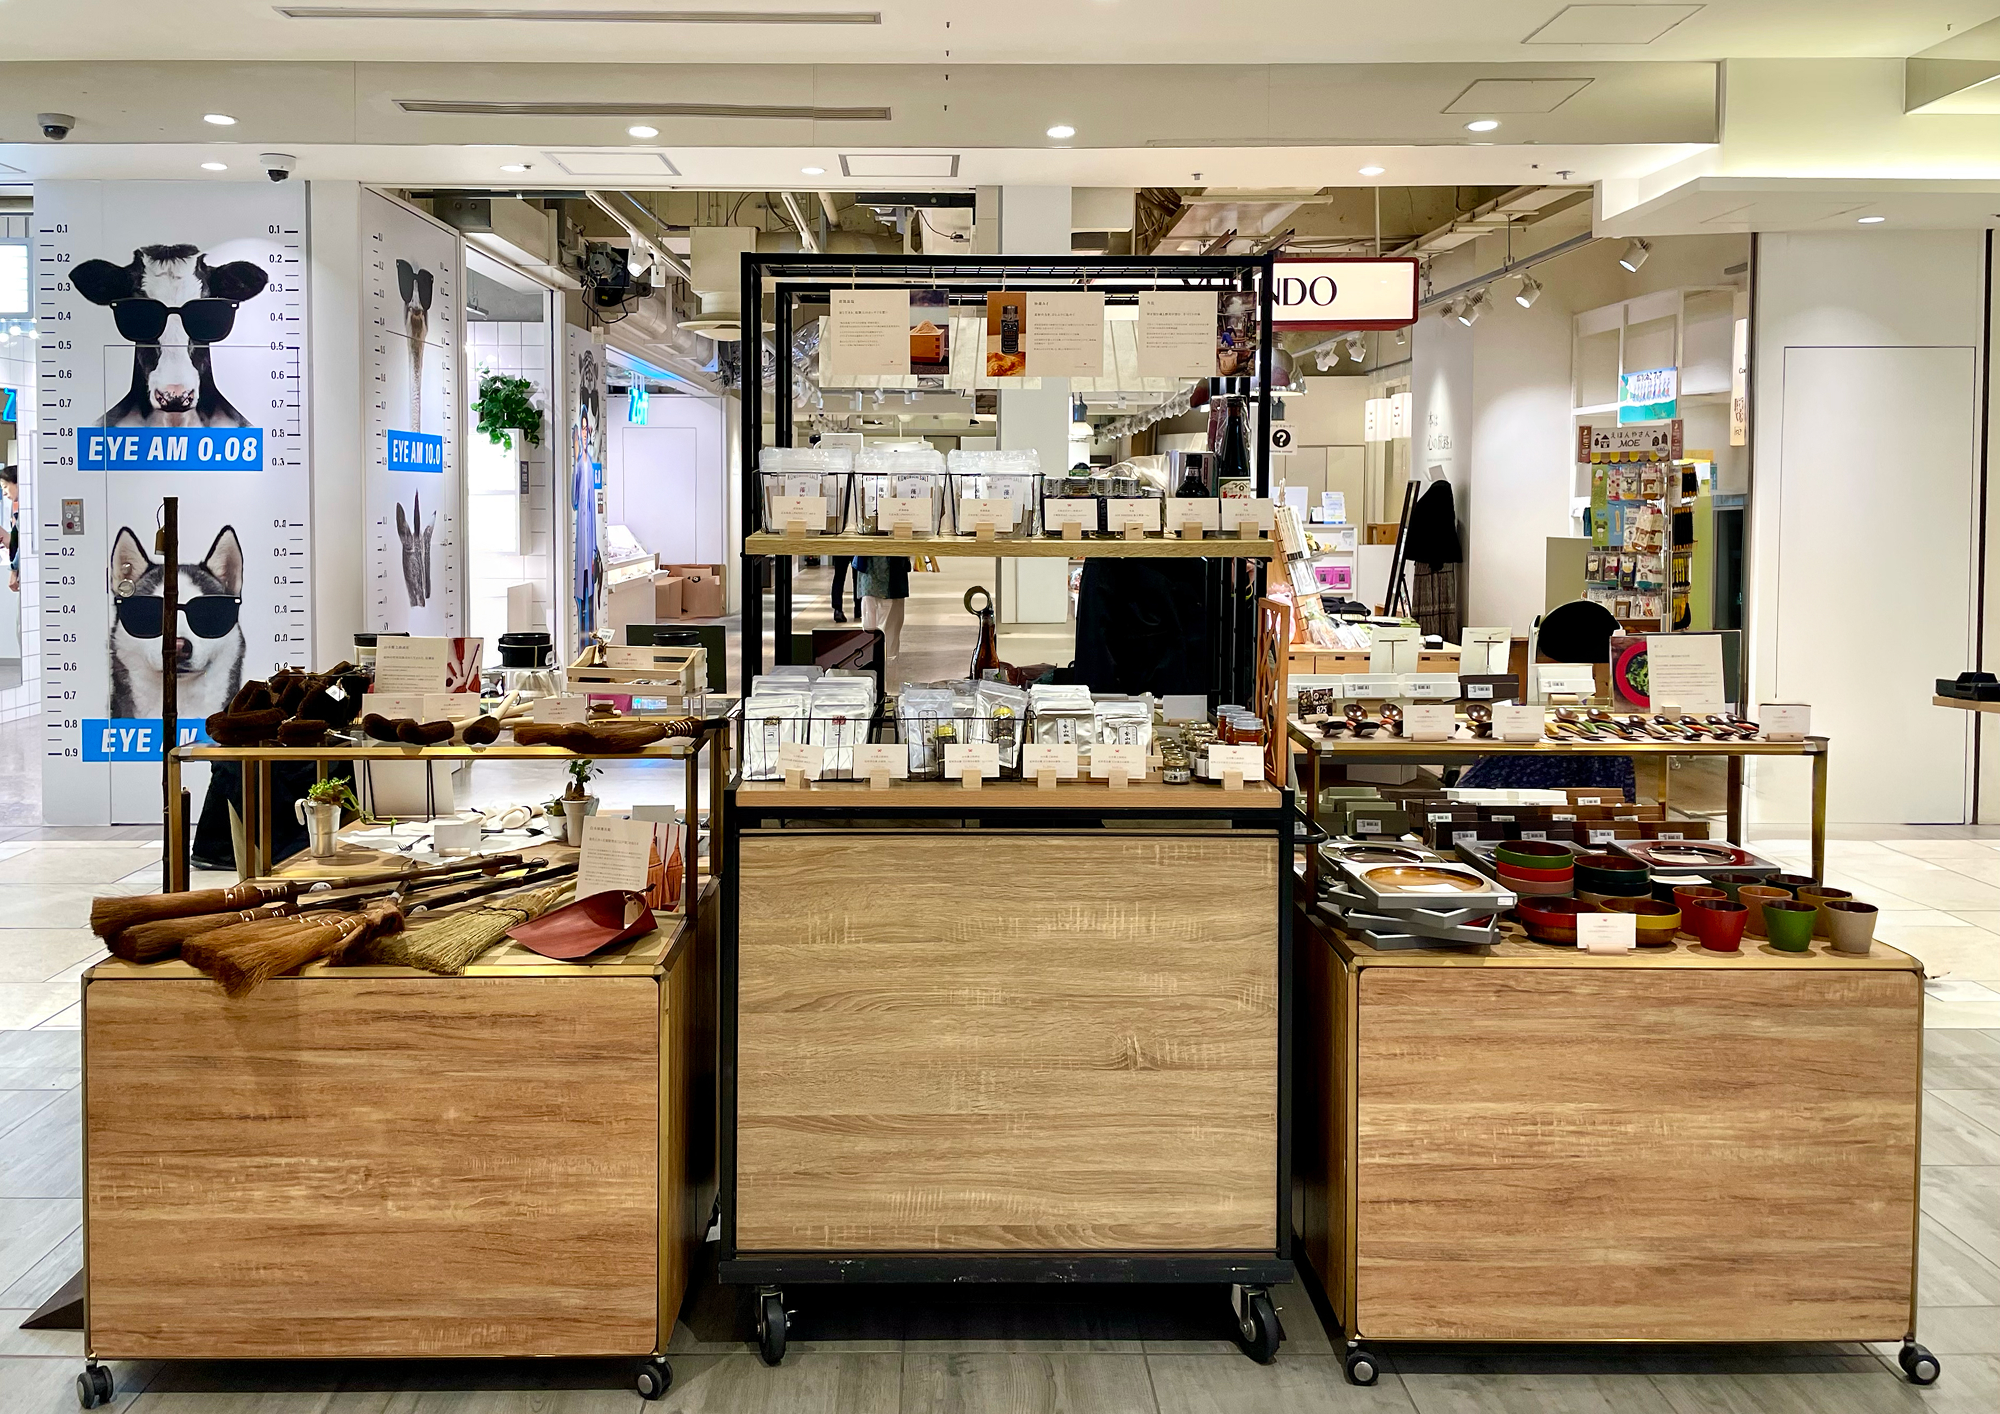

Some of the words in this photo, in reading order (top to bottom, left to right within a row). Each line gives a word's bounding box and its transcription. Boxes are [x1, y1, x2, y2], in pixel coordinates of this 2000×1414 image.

[56, 224, 68, 233] 0.1
[268, 224, 280, 234] 0.1
[57, 253, 70, 263] 0.2
[269, 254, 283, 263] 0.2
[57, 282, 71, 292] 0.3
[269, 283, 283, 293] 0.3
[57, 311, 71, 321] 0.4
[270, 312, 283, 322] 0.4
[58, 340, 72, 350] 0.5
[270, 341, 284, 351] 0.5
[58, 369, 72, 379] 0.6
[271, 370, 285, 380] 0.6
[59, 398, 72, 408] 0.7
[271, 399, 284, 409] 0.7
[59, 427, 73, 437] 0.8
[1611, 431, 1650, 439] えほんやさん
[1618, 439, 1640, 448] MOE
[88, 436, 139, 461] EYE
[147, 436, 188, 461] AM
[198, 436, 258, 462] 0.08
[392, 439, 409, 463] EYE
[410, 440, 423, 464] AM
[425, 442, 440, 465] 10.0
[60, 456, 74, 466] 0.9
[61, 547, 75, 556] 0.2
[62, 576, 76, 585] 0.3
[62, 604, 76, 614] 0.4
[63, 633, 77, 643] 0.5
[63, 662, 77, 671] 0.6
[63, 691, 77, 700] 0.7
[64, 719, 78, 729] 0.8
[101, 728, 152, 753] EYE
[64, 748, 78, 757] 0.9
